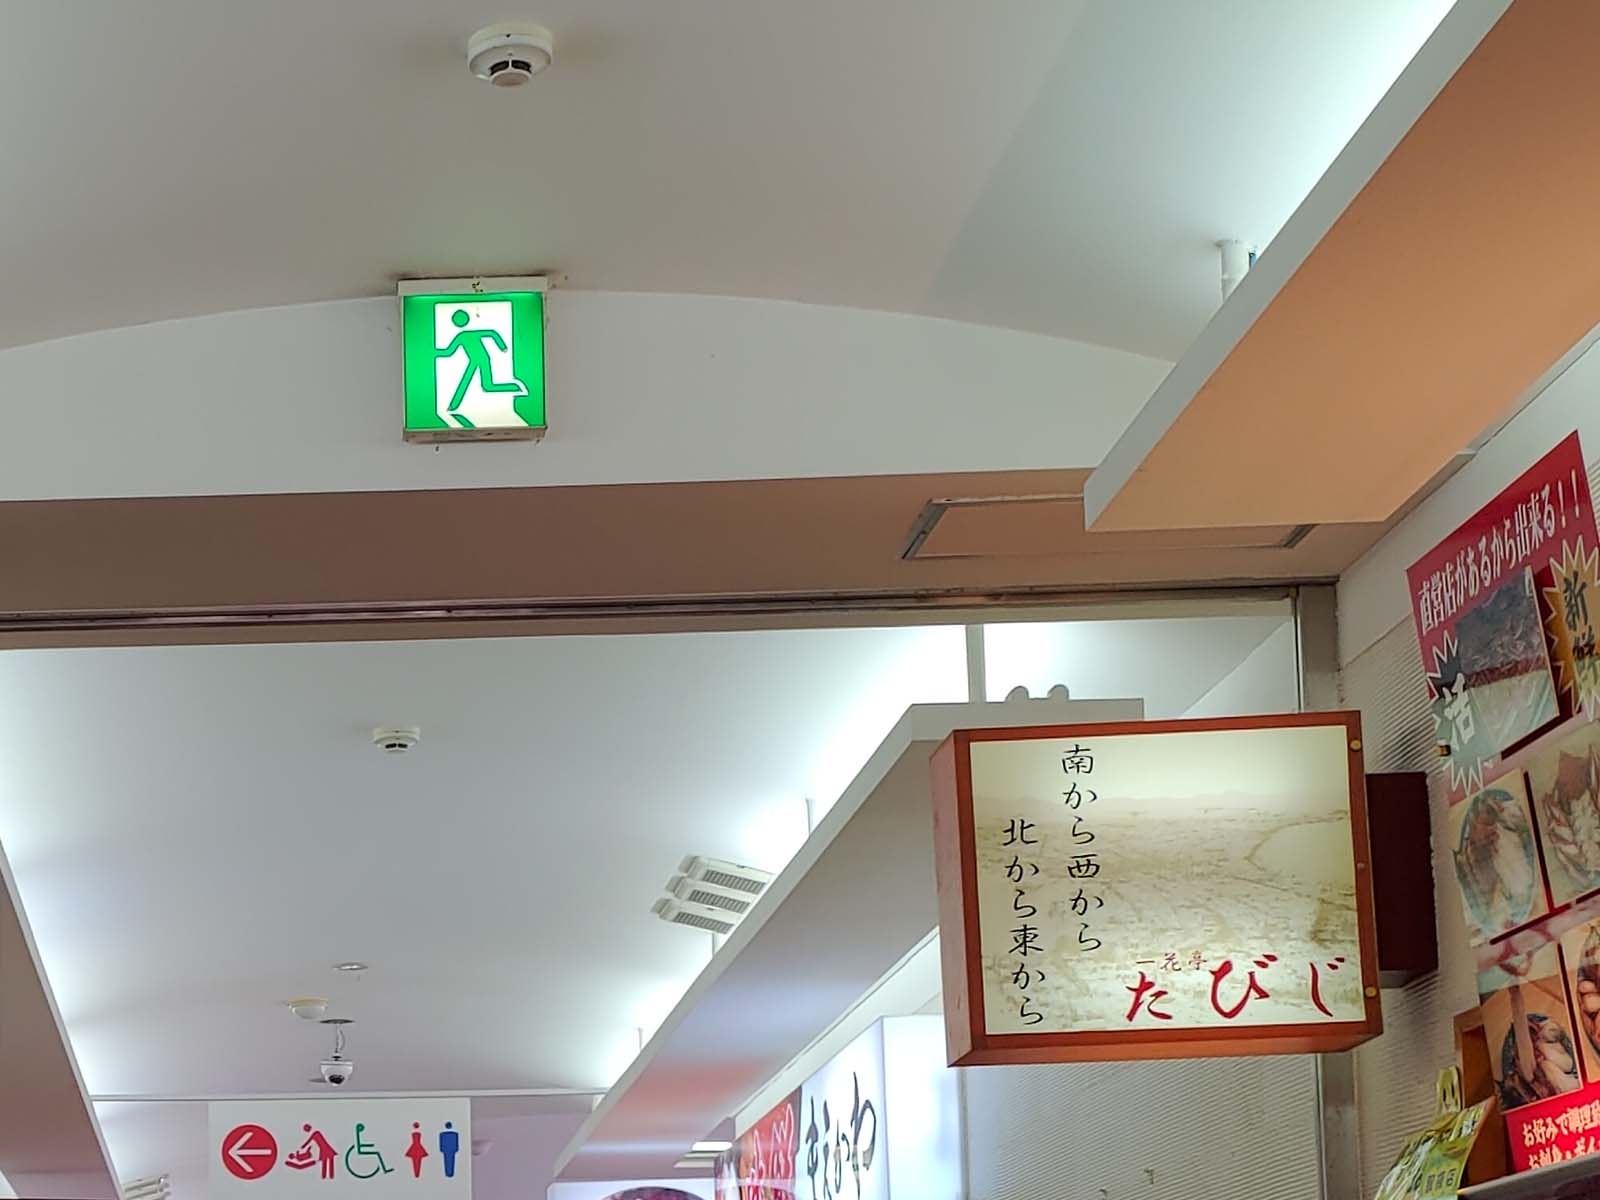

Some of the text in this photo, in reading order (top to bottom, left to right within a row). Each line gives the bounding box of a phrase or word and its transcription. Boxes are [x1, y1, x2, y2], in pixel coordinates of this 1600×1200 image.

[1061, 744, 1104, 952] 南から西から
[1001, 818, 1047, 1026] 北から東から
[1125, 953, 1346, 1023] たびじ
[1135, 951, 1209, 973] 一花亭
